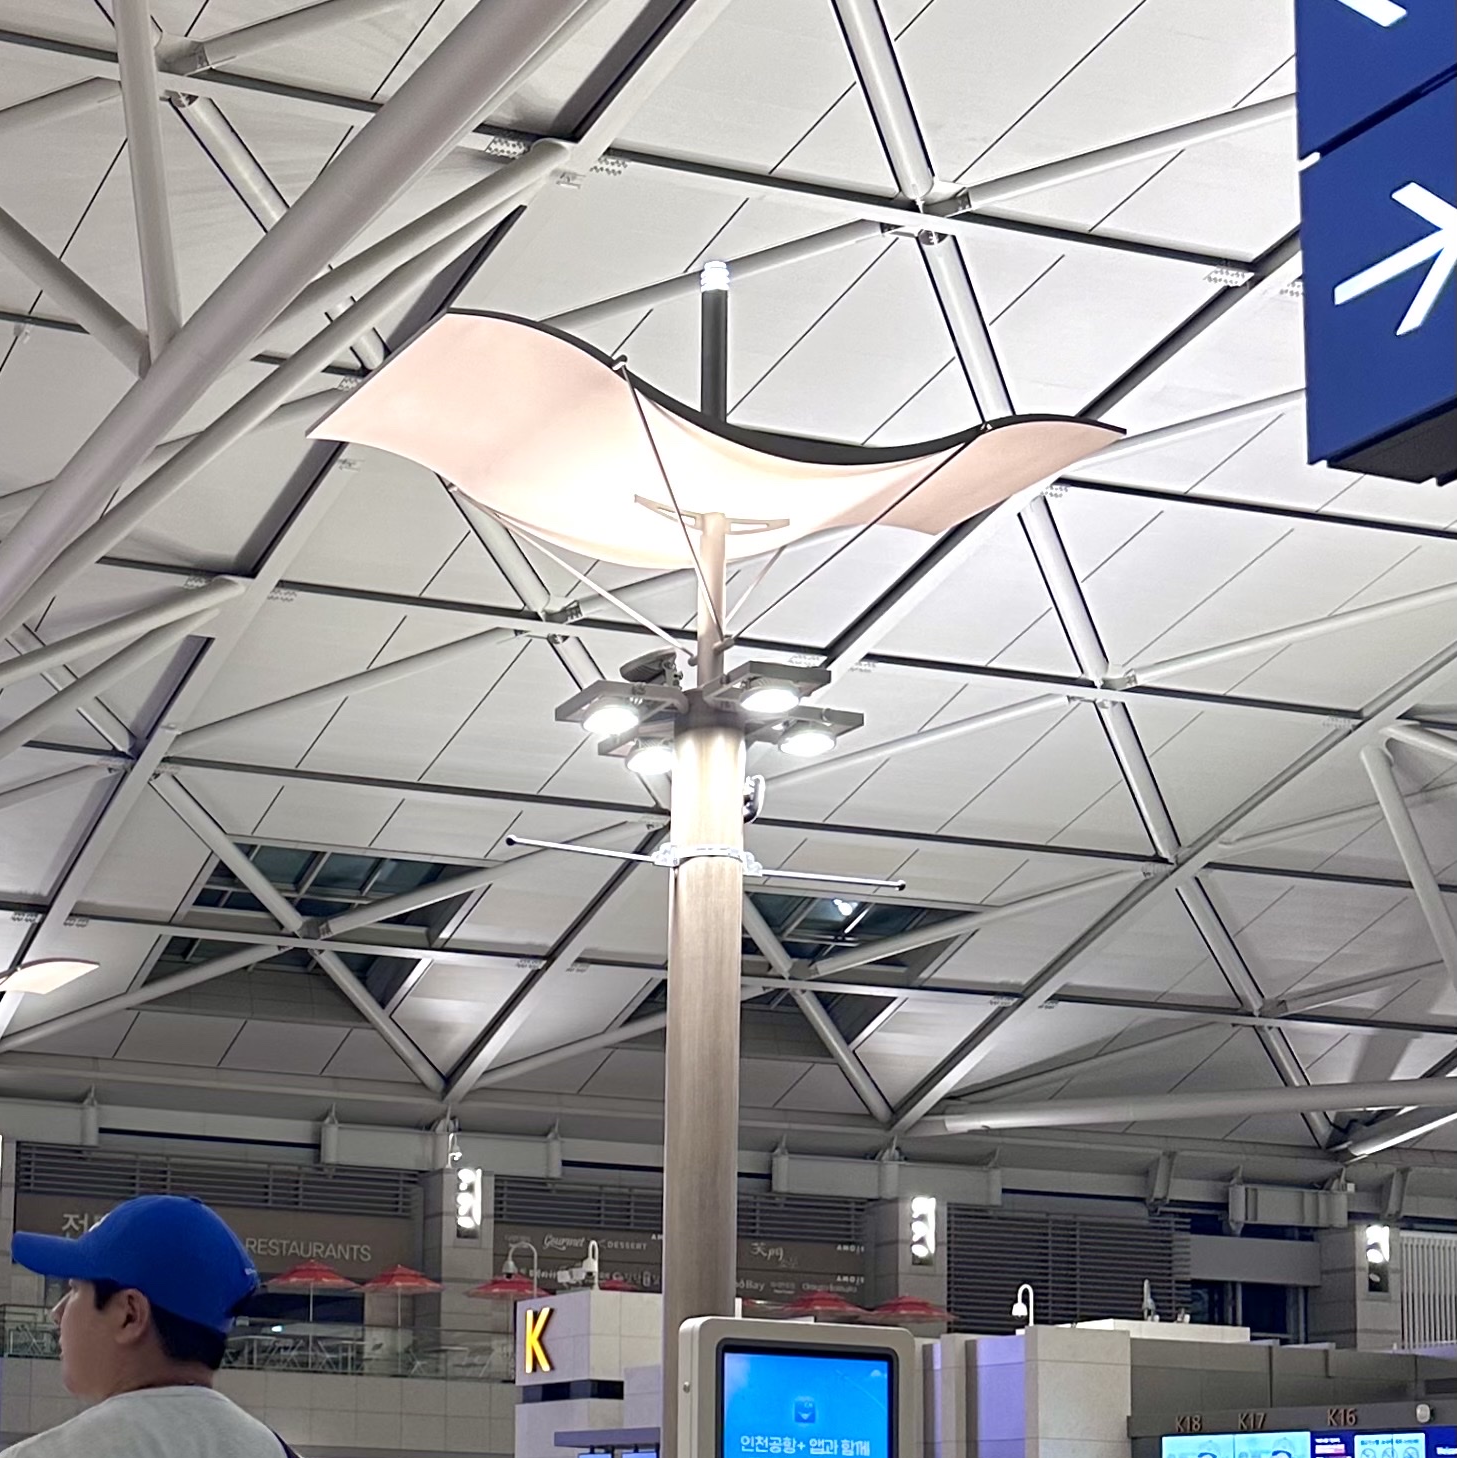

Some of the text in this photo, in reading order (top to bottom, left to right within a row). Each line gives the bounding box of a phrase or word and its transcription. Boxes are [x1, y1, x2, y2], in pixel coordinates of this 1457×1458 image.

[245, 1237, 372, 1262] RESTAURANTS
[525, 1306, 553, 1375] K
[1175, 1414, 1203, 1433] K18
[1238, 1412, 1267, 1431] K17
[1326, 1408, 1357, 1427] K16
